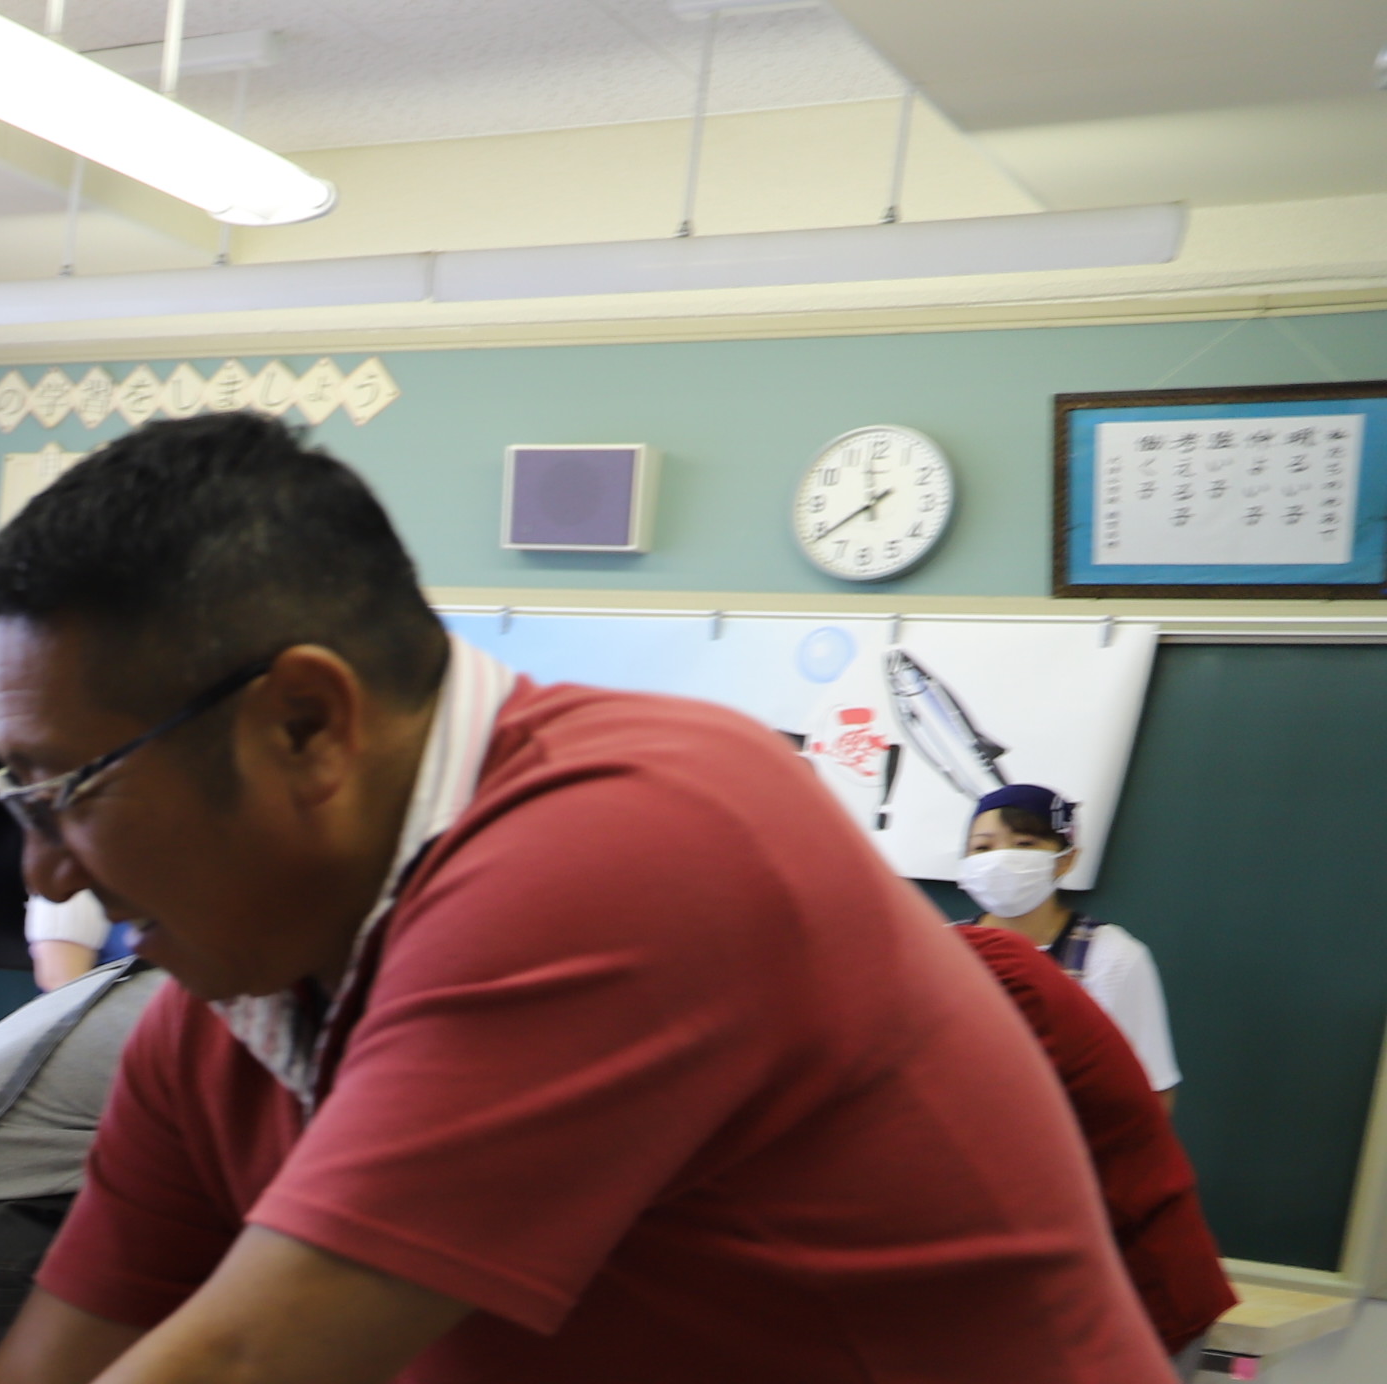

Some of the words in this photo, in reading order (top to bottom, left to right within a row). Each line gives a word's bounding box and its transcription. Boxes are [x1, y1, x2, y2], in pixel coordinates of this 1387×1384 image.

[915, 467, 933, 486] 2
[809, 495, 826, 513] 9
[918, 494, 936, 512] 3
[905, 521, 924, 538] 4
[832, 539, 849, 561] 7
[854, 547, 873, 566] 6
[884, 539, 902, 559] 5
